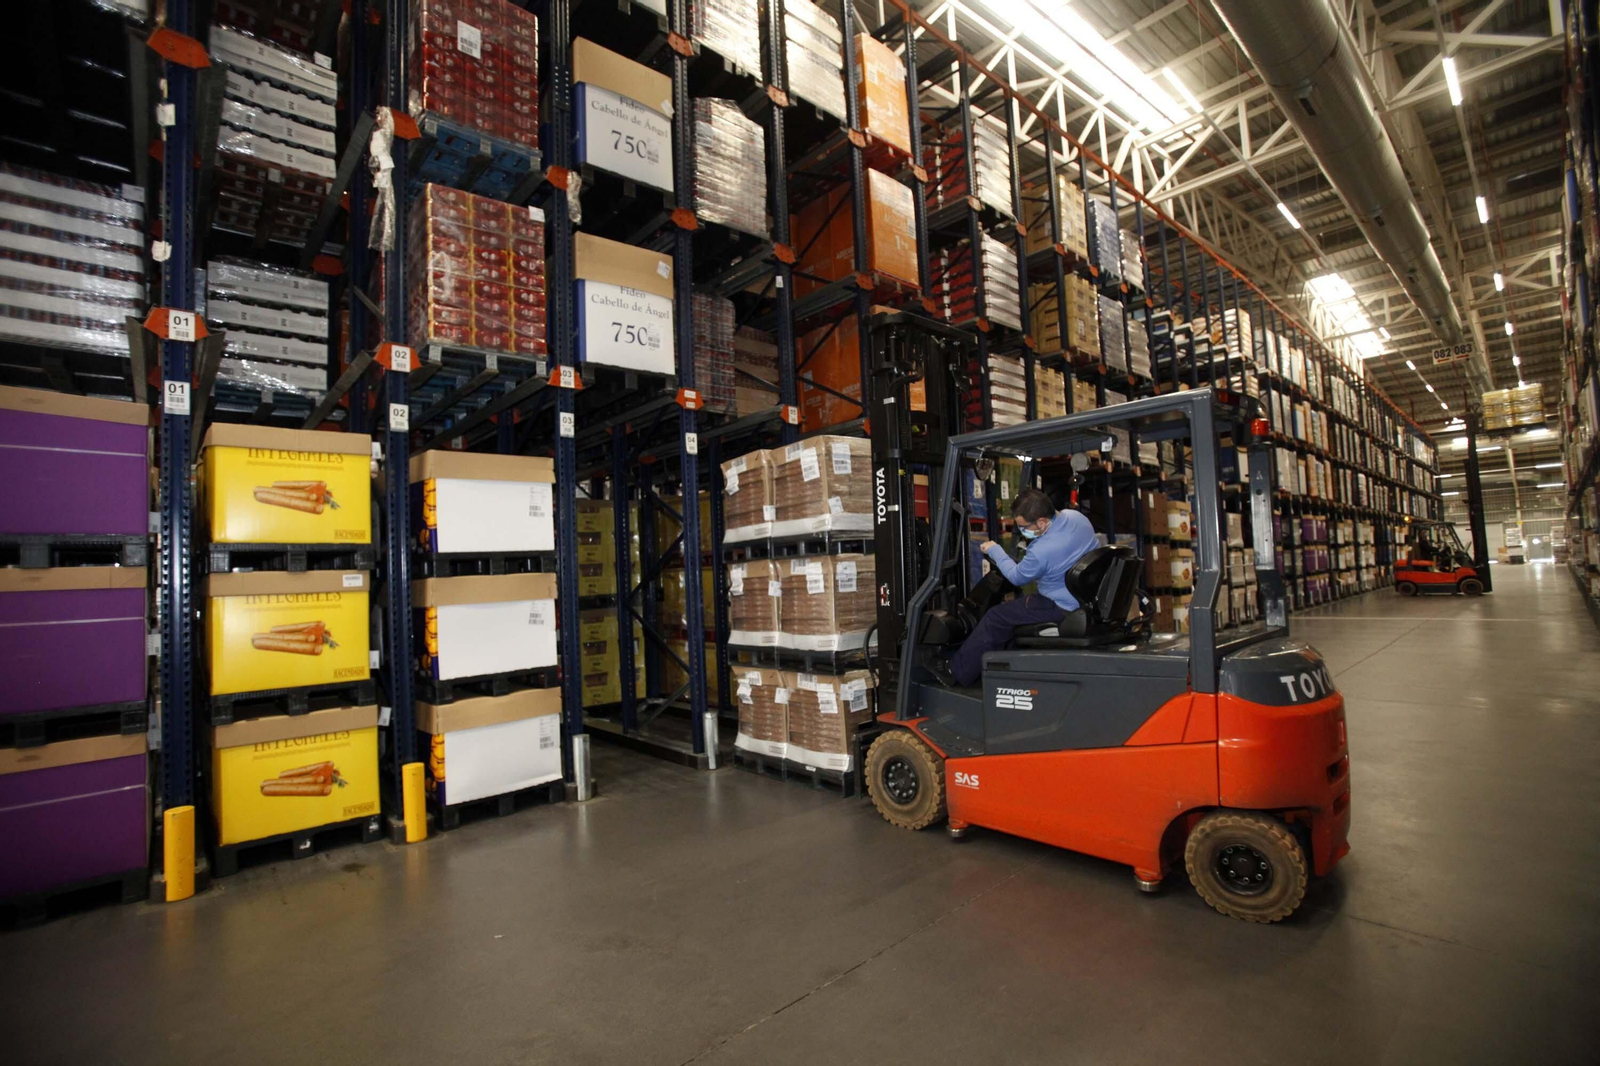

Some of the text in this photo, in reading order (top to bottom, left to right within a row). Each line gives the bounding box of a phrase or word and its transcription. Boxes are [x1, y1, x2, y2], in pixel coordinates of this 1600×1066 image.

[591, 100, 668, 138] Cabello de Ángel
[620, 286, 646, 299] Fideo
[591, 293, 670, 319] Cabello de Ángel
[173, 316, 189, 327] 01
[394, 350, 407, 359] 02
[1434, 348, 1451, 359] 082
[1454, 344, 1473, 355] 083
[562, 369, 572, 378] 03
[168, 383, 185, 394] 01
[393, 408, 406, 418] 02
[562, 416, 572, 425] 03
[876, 467, 887, 525] TOYOTA
[995, 694, 1033, 711] 25
[955, 772, 979, 786] SAS
